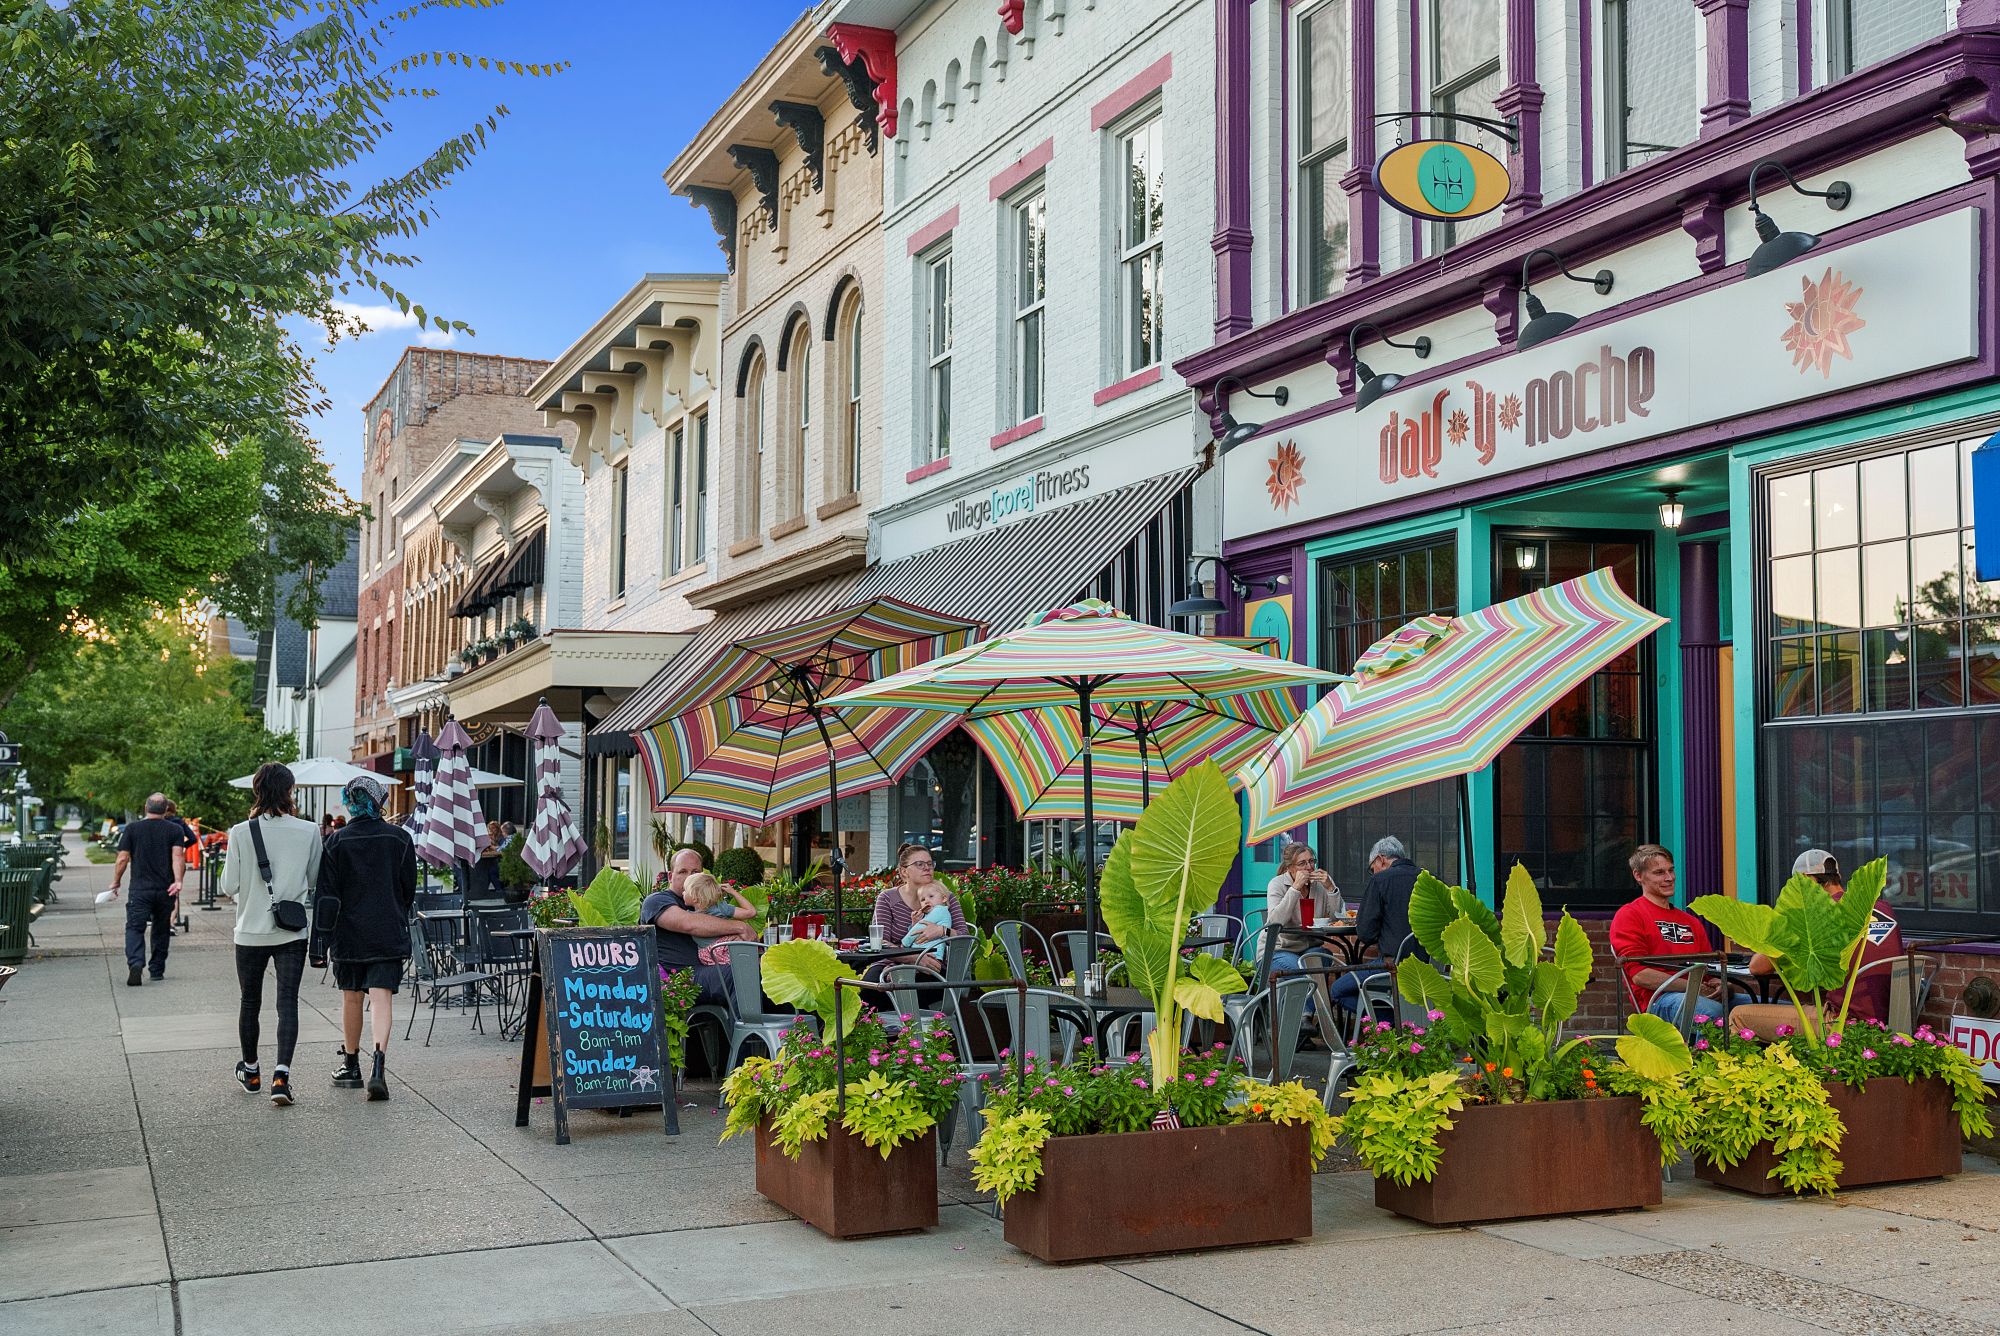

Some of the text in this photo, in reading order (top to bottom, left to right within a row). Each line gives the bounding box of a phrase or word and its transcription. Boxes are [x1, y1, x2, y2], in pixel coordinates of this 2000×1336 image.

[1525, 343, 1655, 447] noche
[568, 942, 640, 969] HOURS
[564, 976, 648, 1003] Monday
[579, 1030, 642, 1051] 8am-9pm
[565, 1049, 637, 1076] Sunday
[575, 1076, 629, 1094] 8am-2pm
